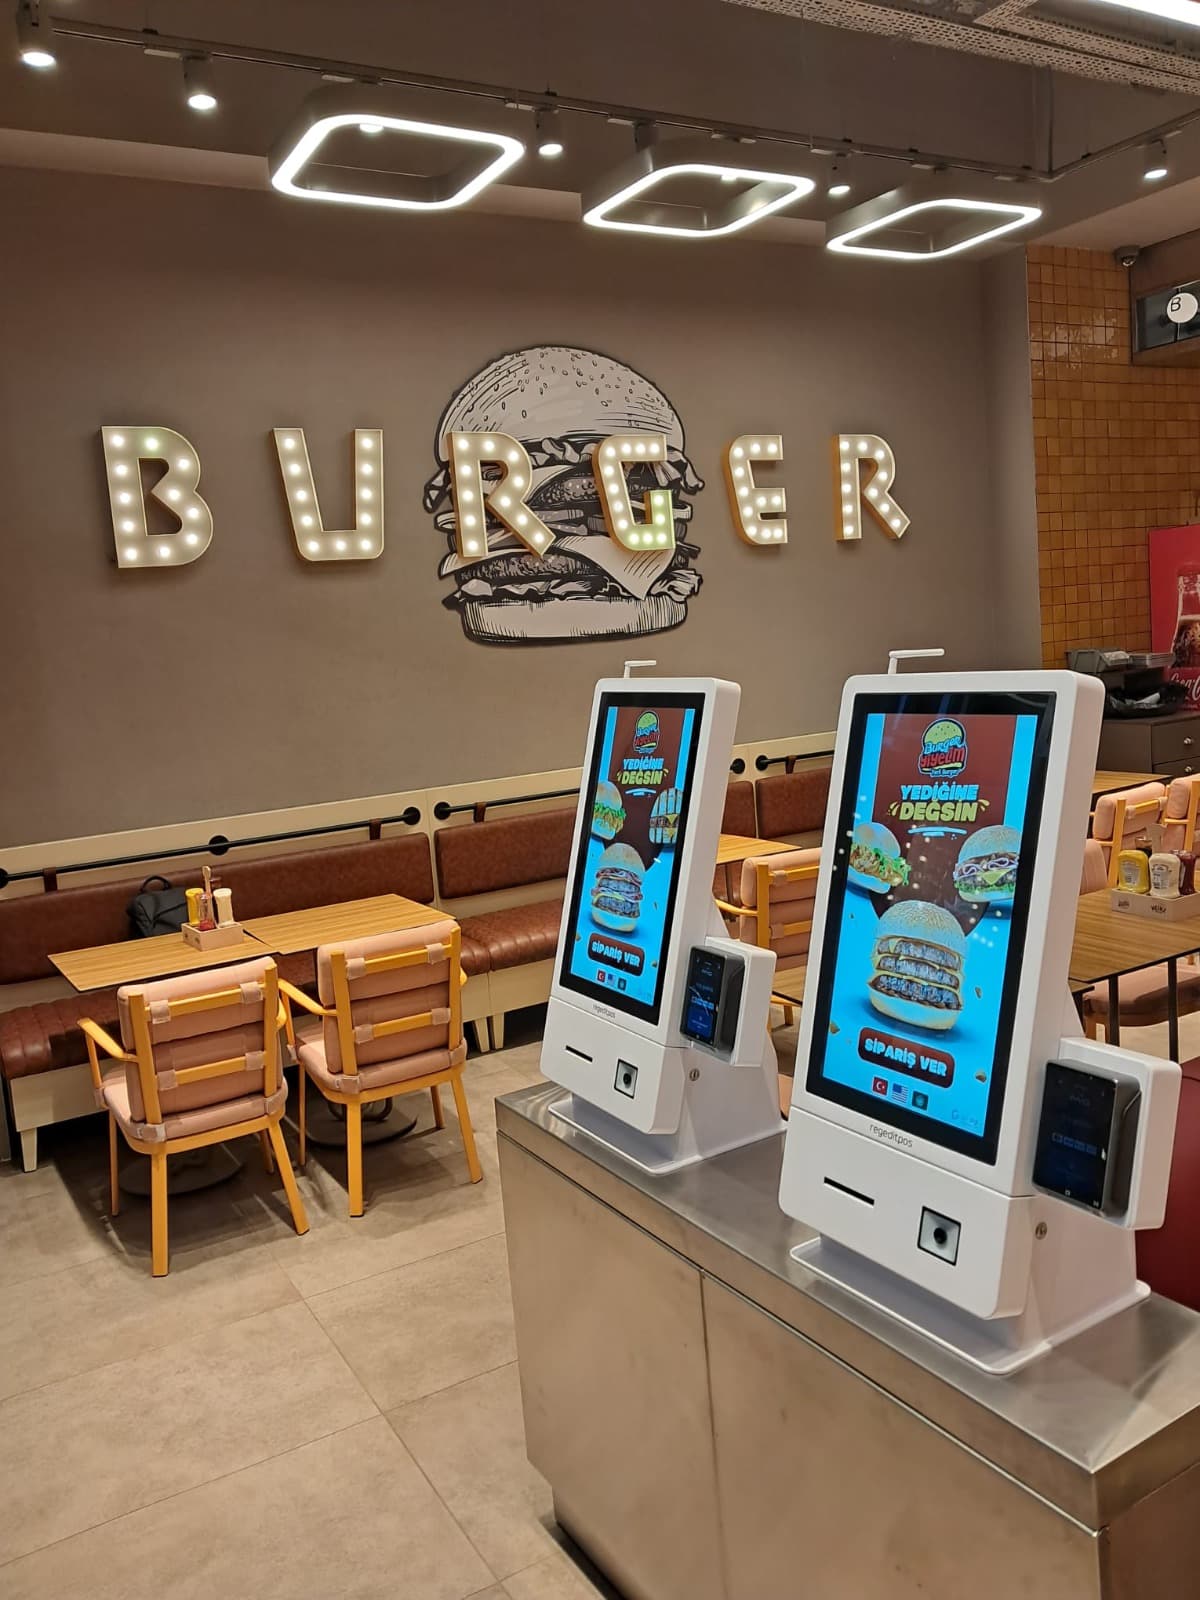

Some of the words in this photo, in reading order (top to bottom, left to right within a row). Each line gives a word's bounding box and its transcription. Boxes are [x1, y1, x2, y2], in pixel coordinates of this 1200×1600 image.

[1170, 296, 1181, 313] B
[100, 424, 911, 569] BURGER
[900, 781, 979, 801] YEDİĞİNE
[899, 798, 979, 822] DEĞSİN
[623, 951, 641, 967] VER
[864, 1037, 917, 1069] SİPARİŞ
[920, 1055, 948, 1077] VER
[869, 1122, 914, 1148] regeditpos
